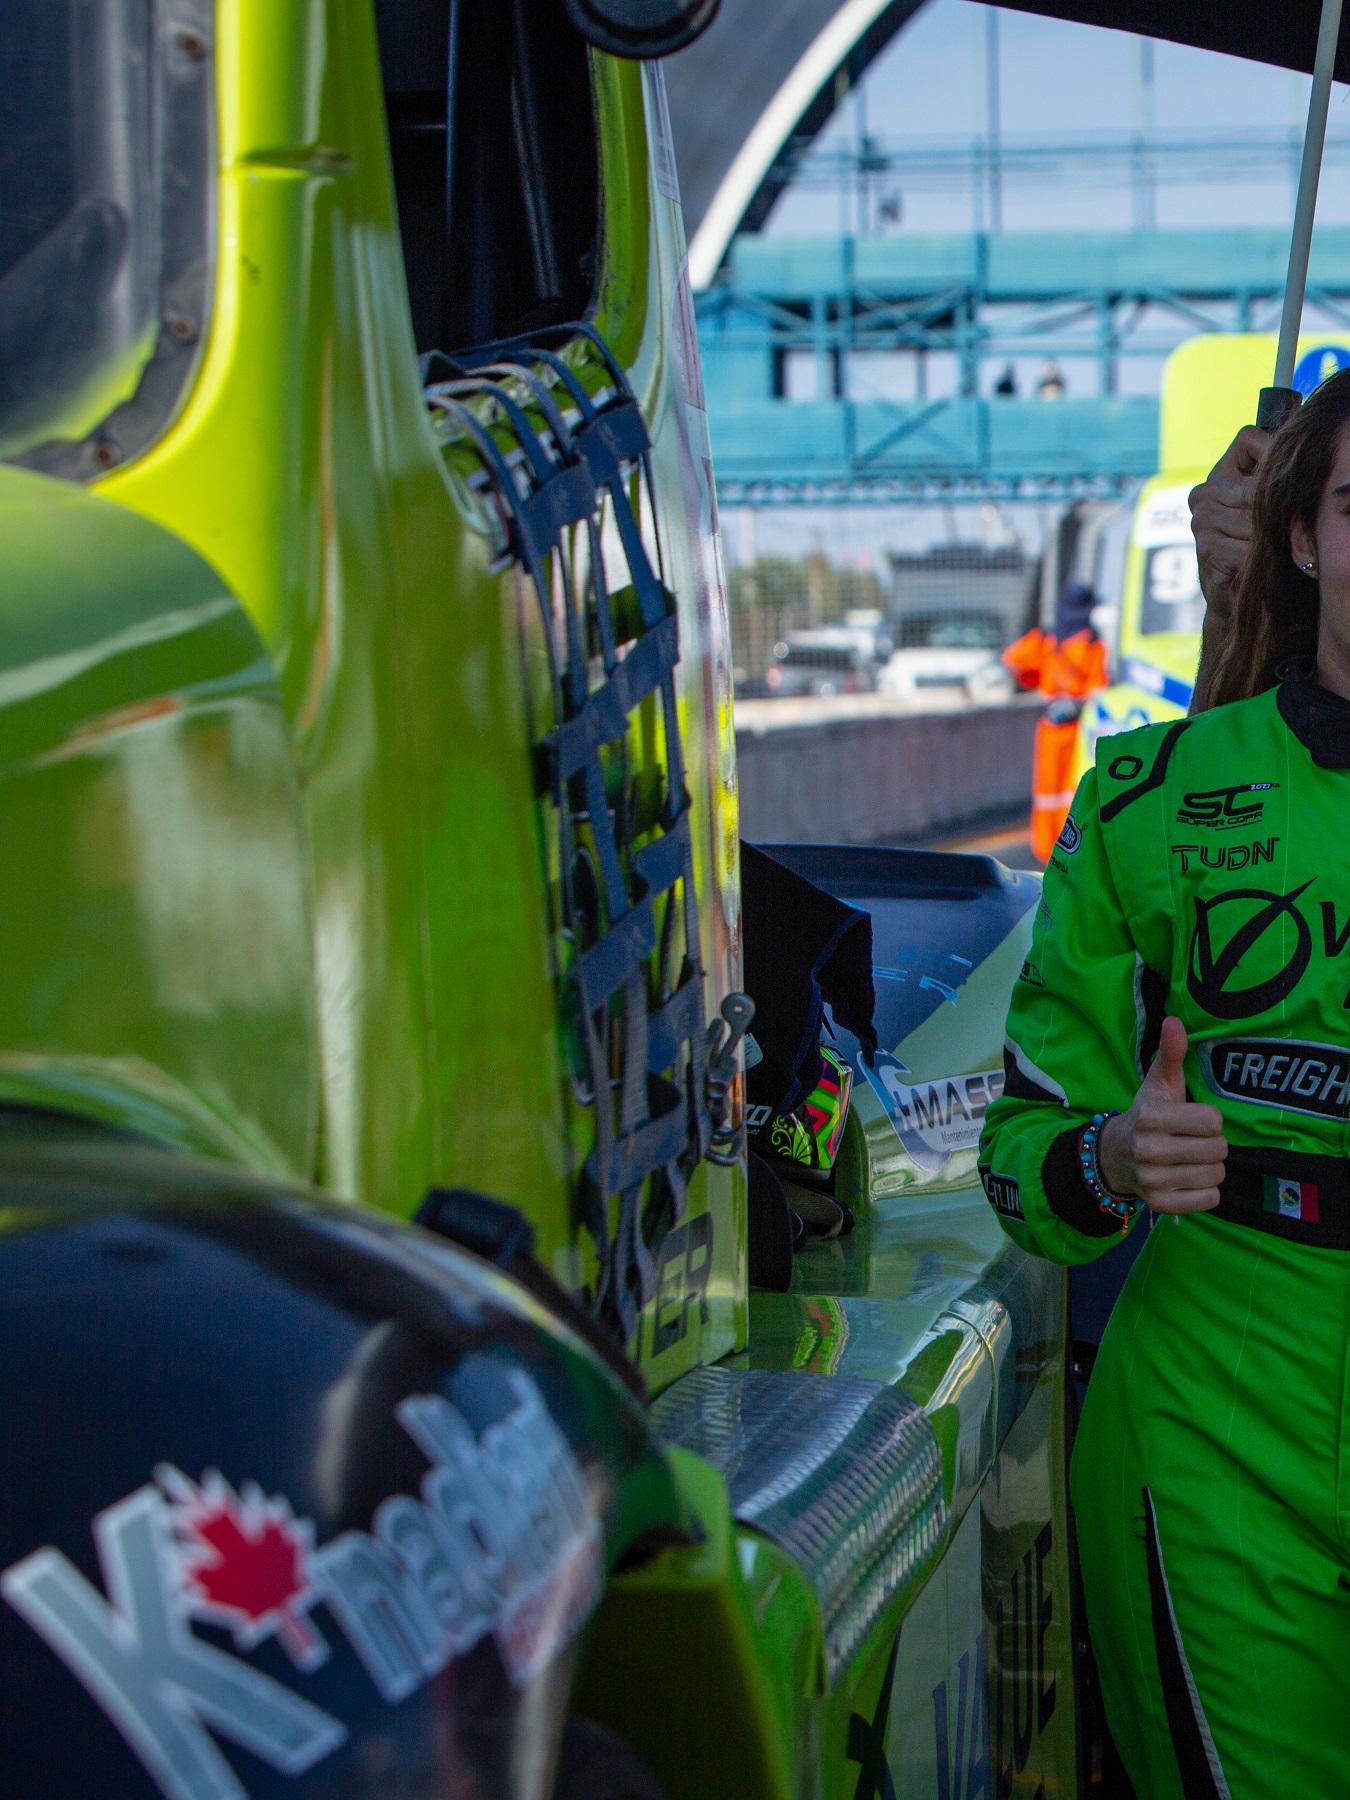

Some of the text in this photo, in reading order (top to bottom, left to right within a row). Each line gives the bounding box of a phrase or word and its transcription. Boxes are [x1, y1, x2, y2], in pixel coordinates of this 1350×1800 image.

[1176, 810, 1263, 828] SUPER COPA
[1171, 836, 1281, 874] TUDN
